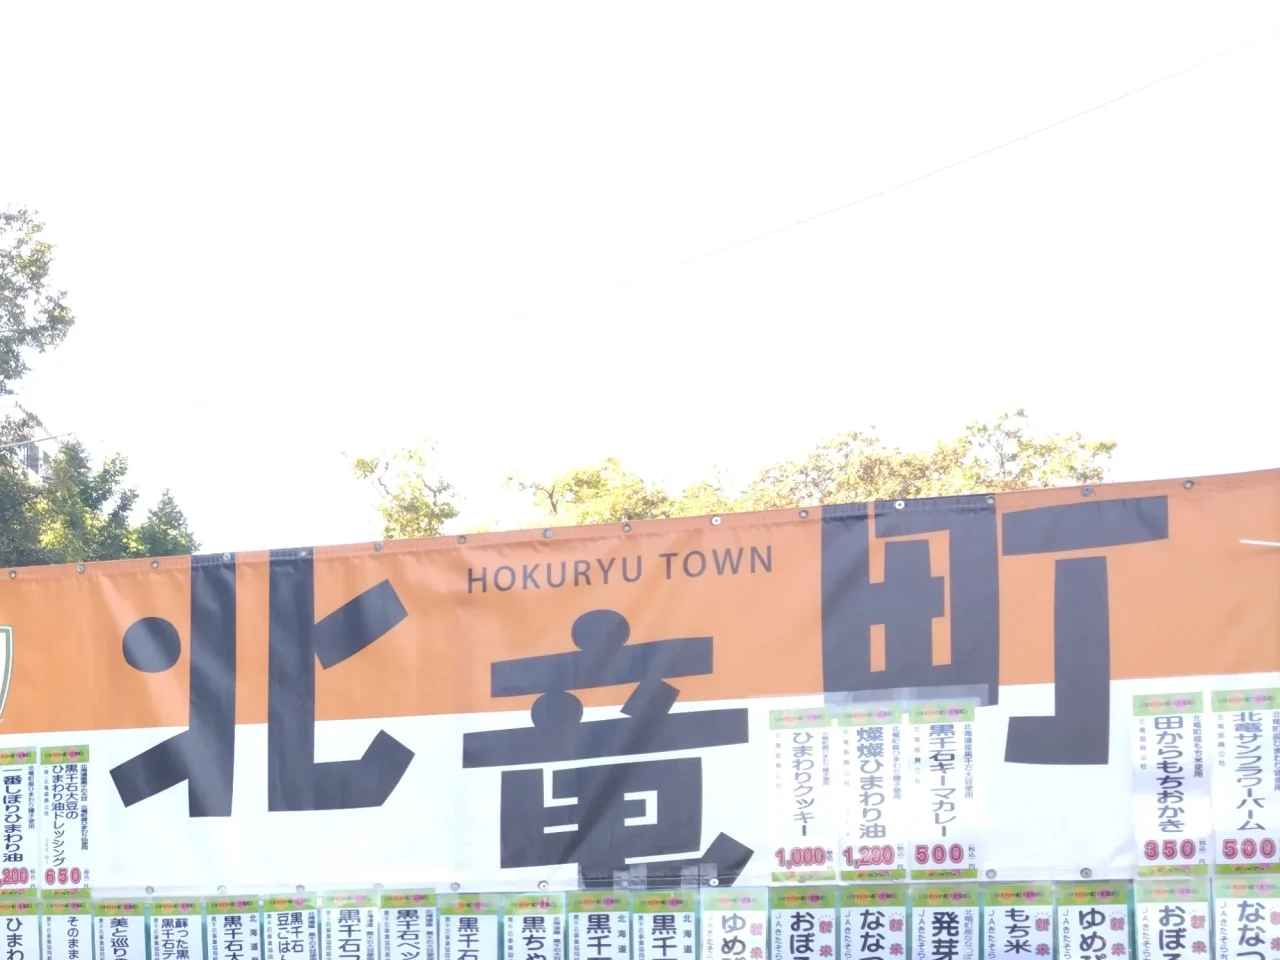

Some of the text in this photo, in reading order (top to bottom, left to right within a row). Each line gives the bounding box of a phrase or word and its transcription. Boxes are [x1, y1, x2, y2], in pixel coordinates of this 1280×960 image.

[466, 544, 774, 594] HOKURYU TOWN
[108, 494, 1170, 888] 北竜町
[65, 764, 79, 820] 黒千石大豆の
[792, 731, 815, 836] ひまわりクッキー
[857, 726, 886, 839] 燦燦ひまわり油
[928, 723, 957, 837] 黒千石キーマカレー
[1154, 715, 1186, 833] 田からもちおかき
[1232, 711, 1266, 831] 北竜サンフラワーバーム
[2, 768, 24, 863] 一番しぼりひまわり油
[52, 764, 66, 867] ひまわり油ドレッシング
[775, 846, 827, 869] 1,000
[842, 845, 895, 869] 1,200
[915, 843, 965, 865] 500
[1143, 839, 1197, 861] 350
[1222, 837, 1276, 860] 500
[45, 867, 82, 885] 650
[290, 911, 304, 953] 黒千石
[1004, 908, 1032, 954] もち米
